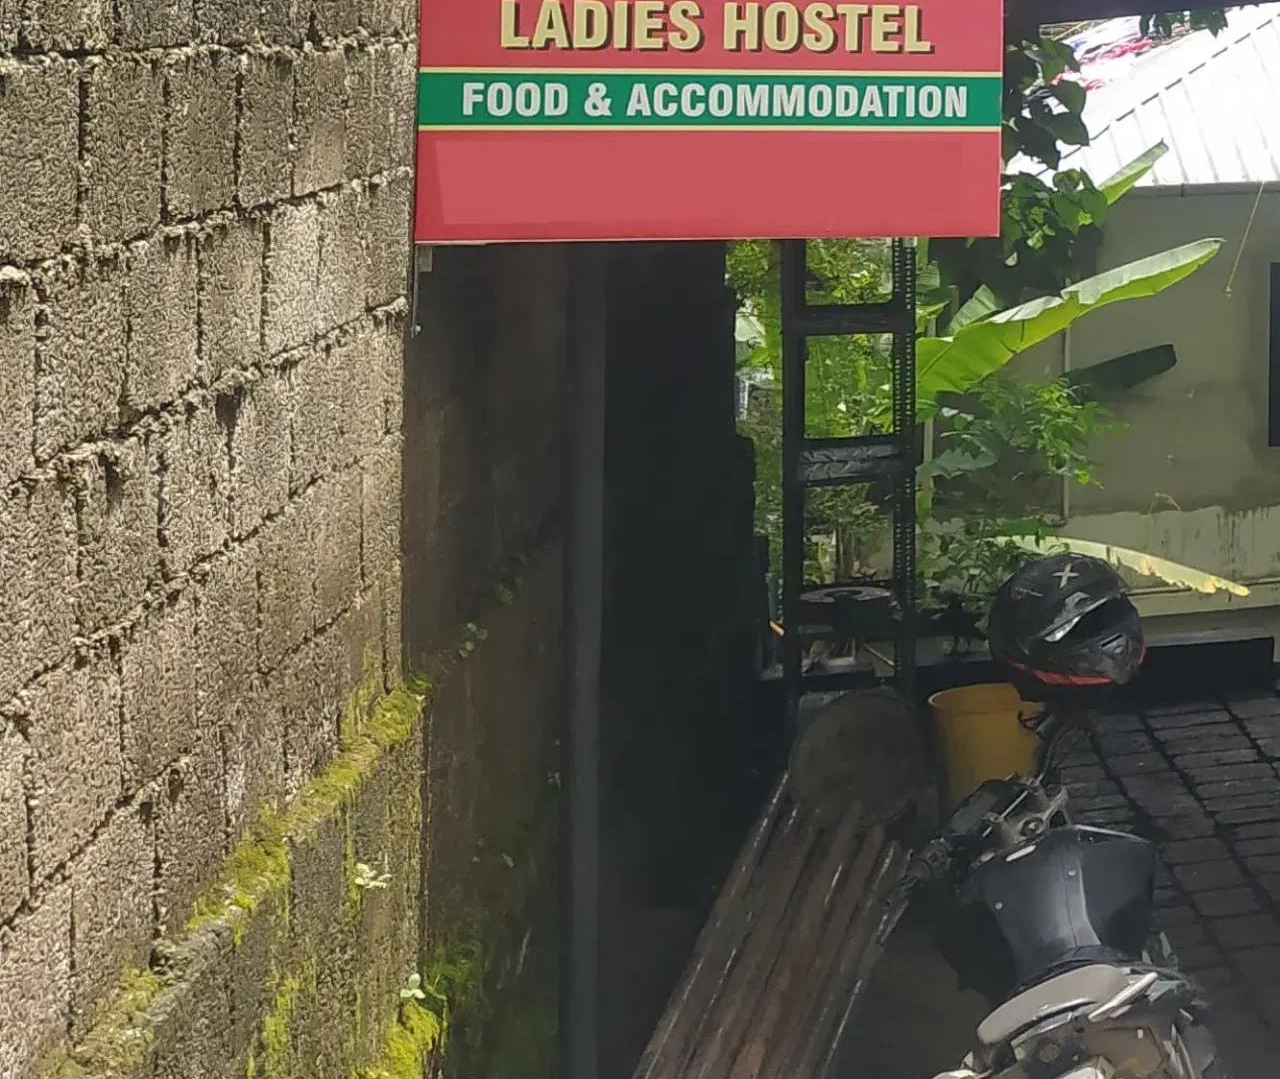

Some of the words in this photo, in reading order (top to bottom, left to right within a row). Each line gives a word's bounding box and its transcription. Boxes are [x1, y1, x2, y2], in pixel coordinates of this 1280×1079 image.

[723, 1, 933, 53] HOSTEL
[462, 82, 568, 117] FOOD
[584, 82, 612, 118] &
[627, 83, 967, 119] ACCOMMODATION
